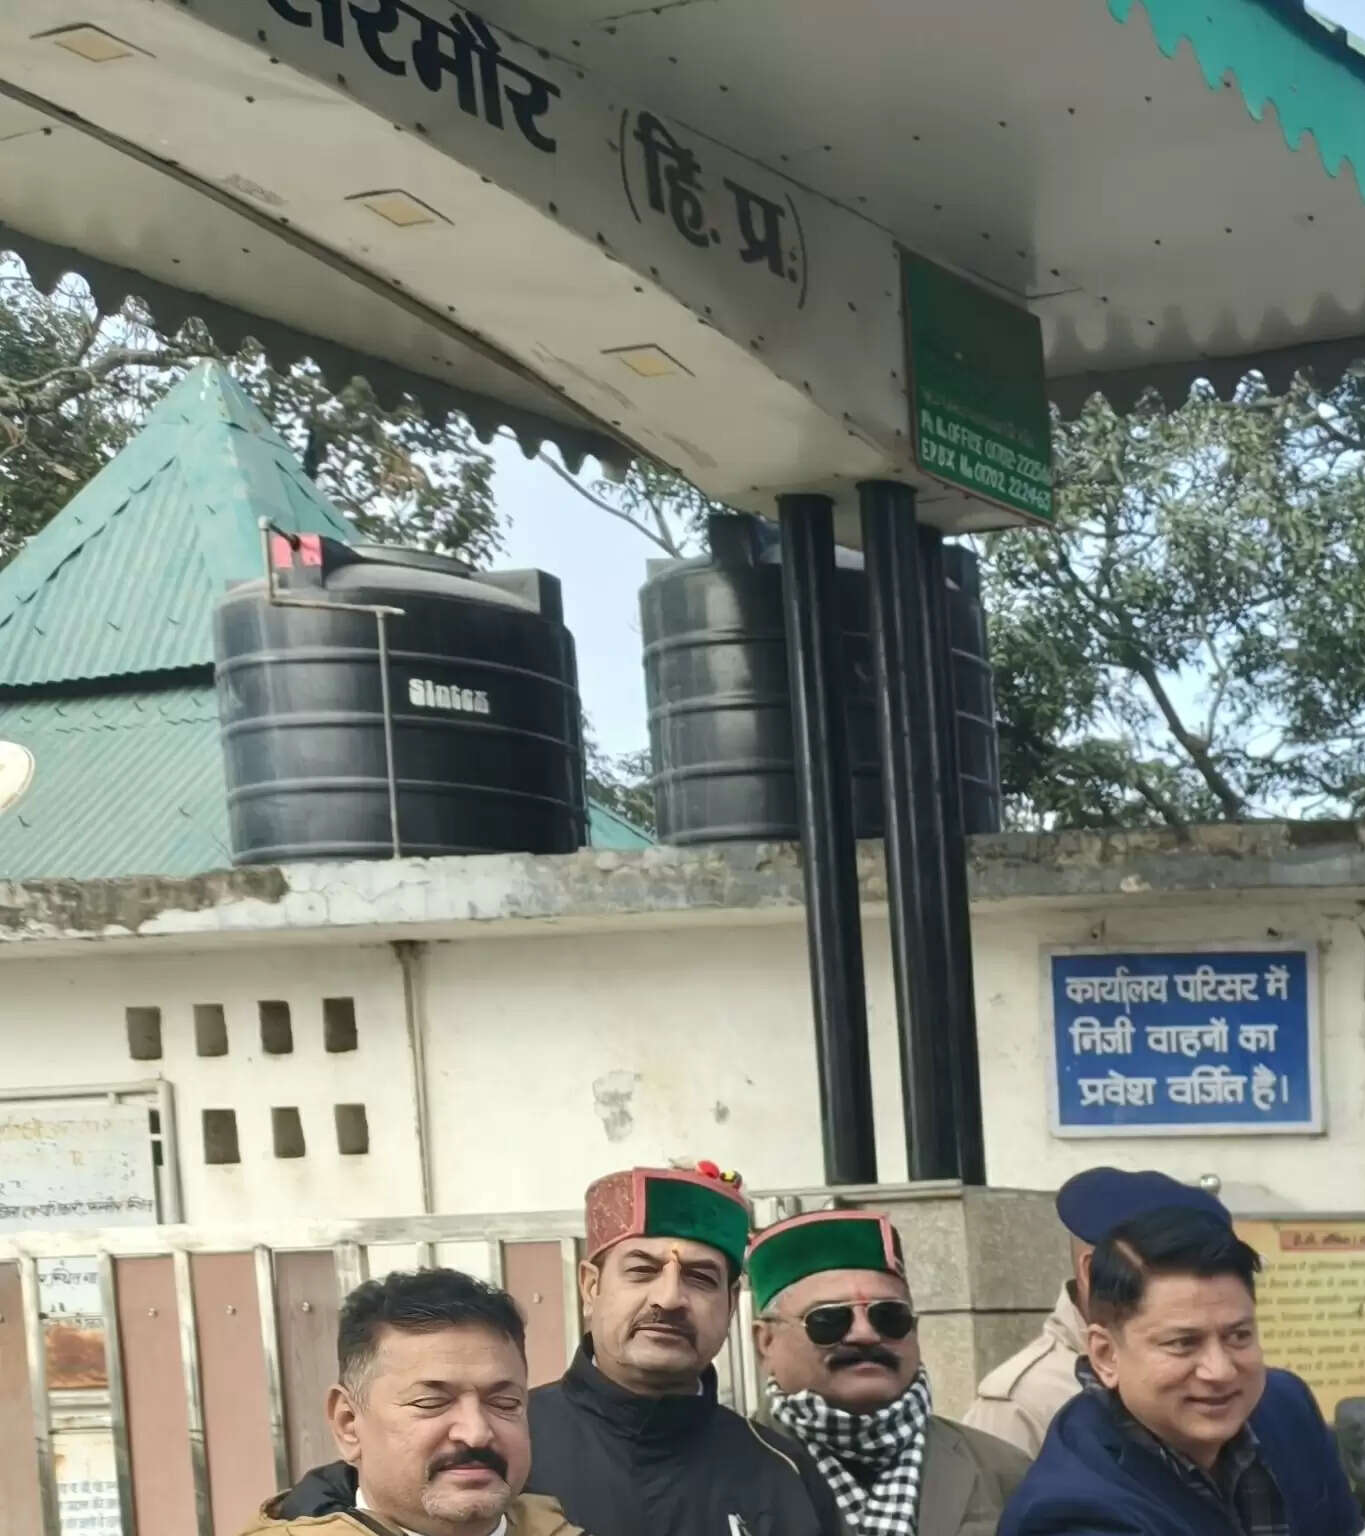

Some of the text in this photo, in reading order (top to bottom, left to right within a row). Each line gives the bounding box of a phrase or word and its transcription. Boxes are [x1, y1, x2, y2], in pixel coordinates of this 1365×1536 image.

[1065, 964, 1290, 1014] कार्यालय परिसर में
[1068, 1016, 1278, 1057] निजी वाहनों का
[1078, 1069, 1156, 1107] प्रवेश
[1166, 1065, 1247, 1104] वर्जित
